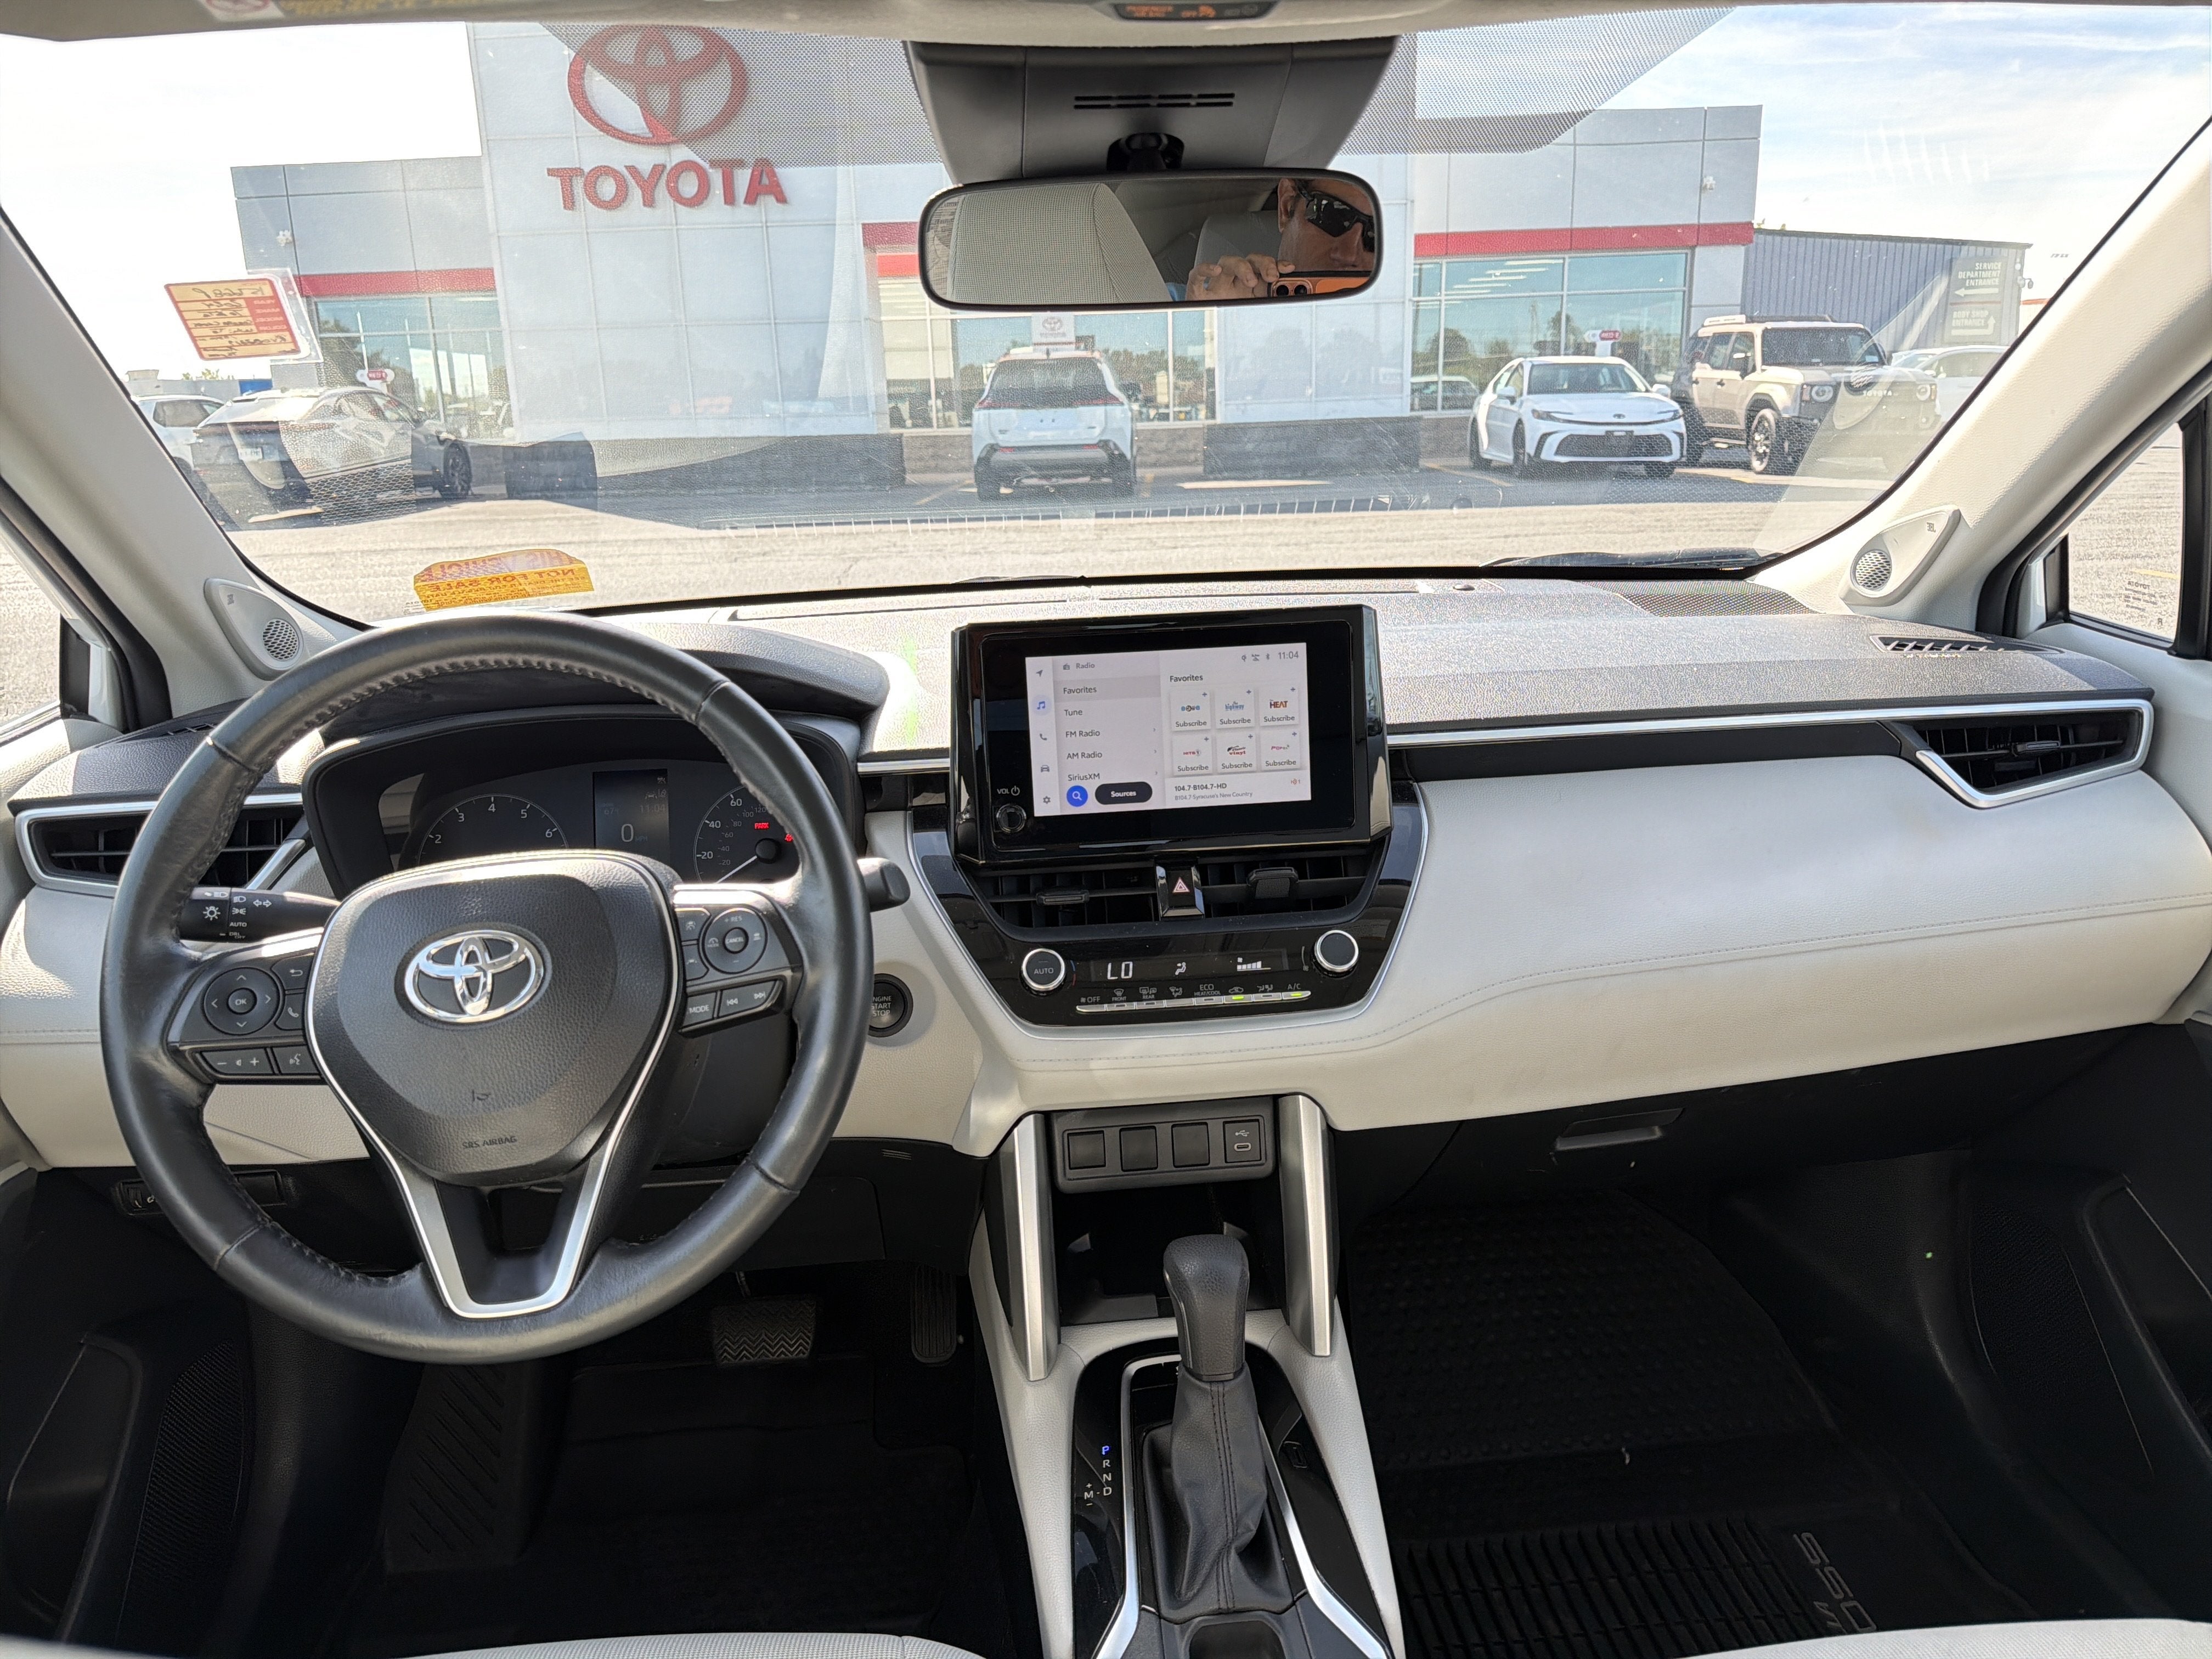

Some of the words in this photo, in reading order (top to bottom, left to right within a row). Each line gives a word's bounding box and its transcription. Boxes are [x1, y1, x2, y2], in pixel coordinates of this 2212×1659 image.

[547, 157, 787, 211] TOYOTA
[1975, 262, 2002, 270] SERVICE
[1971, 310, 1989, 318] SHOP
[1952, 318, 1985, 326] ENTRANCE
[1278, 651, 1299, 659] 11:04
[1170, 674, 1203, 682] Favorites
[1269, 701, 1288, 709] HEAT
[1068, 773, 1100, 781] SiriusXM
[488, 803, 496, 812] 4
[458, 813, 465, 822] 3
[521, 809, 527, 819] 5
[709, 820, 721, 828] 40
[545, 829, 553, 838] 6
[621, 823, 634, 842] 0
[435, 834, 442, 844] 2
[1107, 961, 1133, 979] LO
[689, 1004, 709, 1013] MODE
[462, 1141, 480, 1149] SRS
[483, 1136, 517, 1147] AIRBAG
[1102, 1446, 1109, 1455] P
[1103, 1459, 1111, 1468] R
[1103, 1473, 1111, 1482] N
[1084, 1491, 1093, 1499] M
[1103, 1487, 1112, 1496] D
